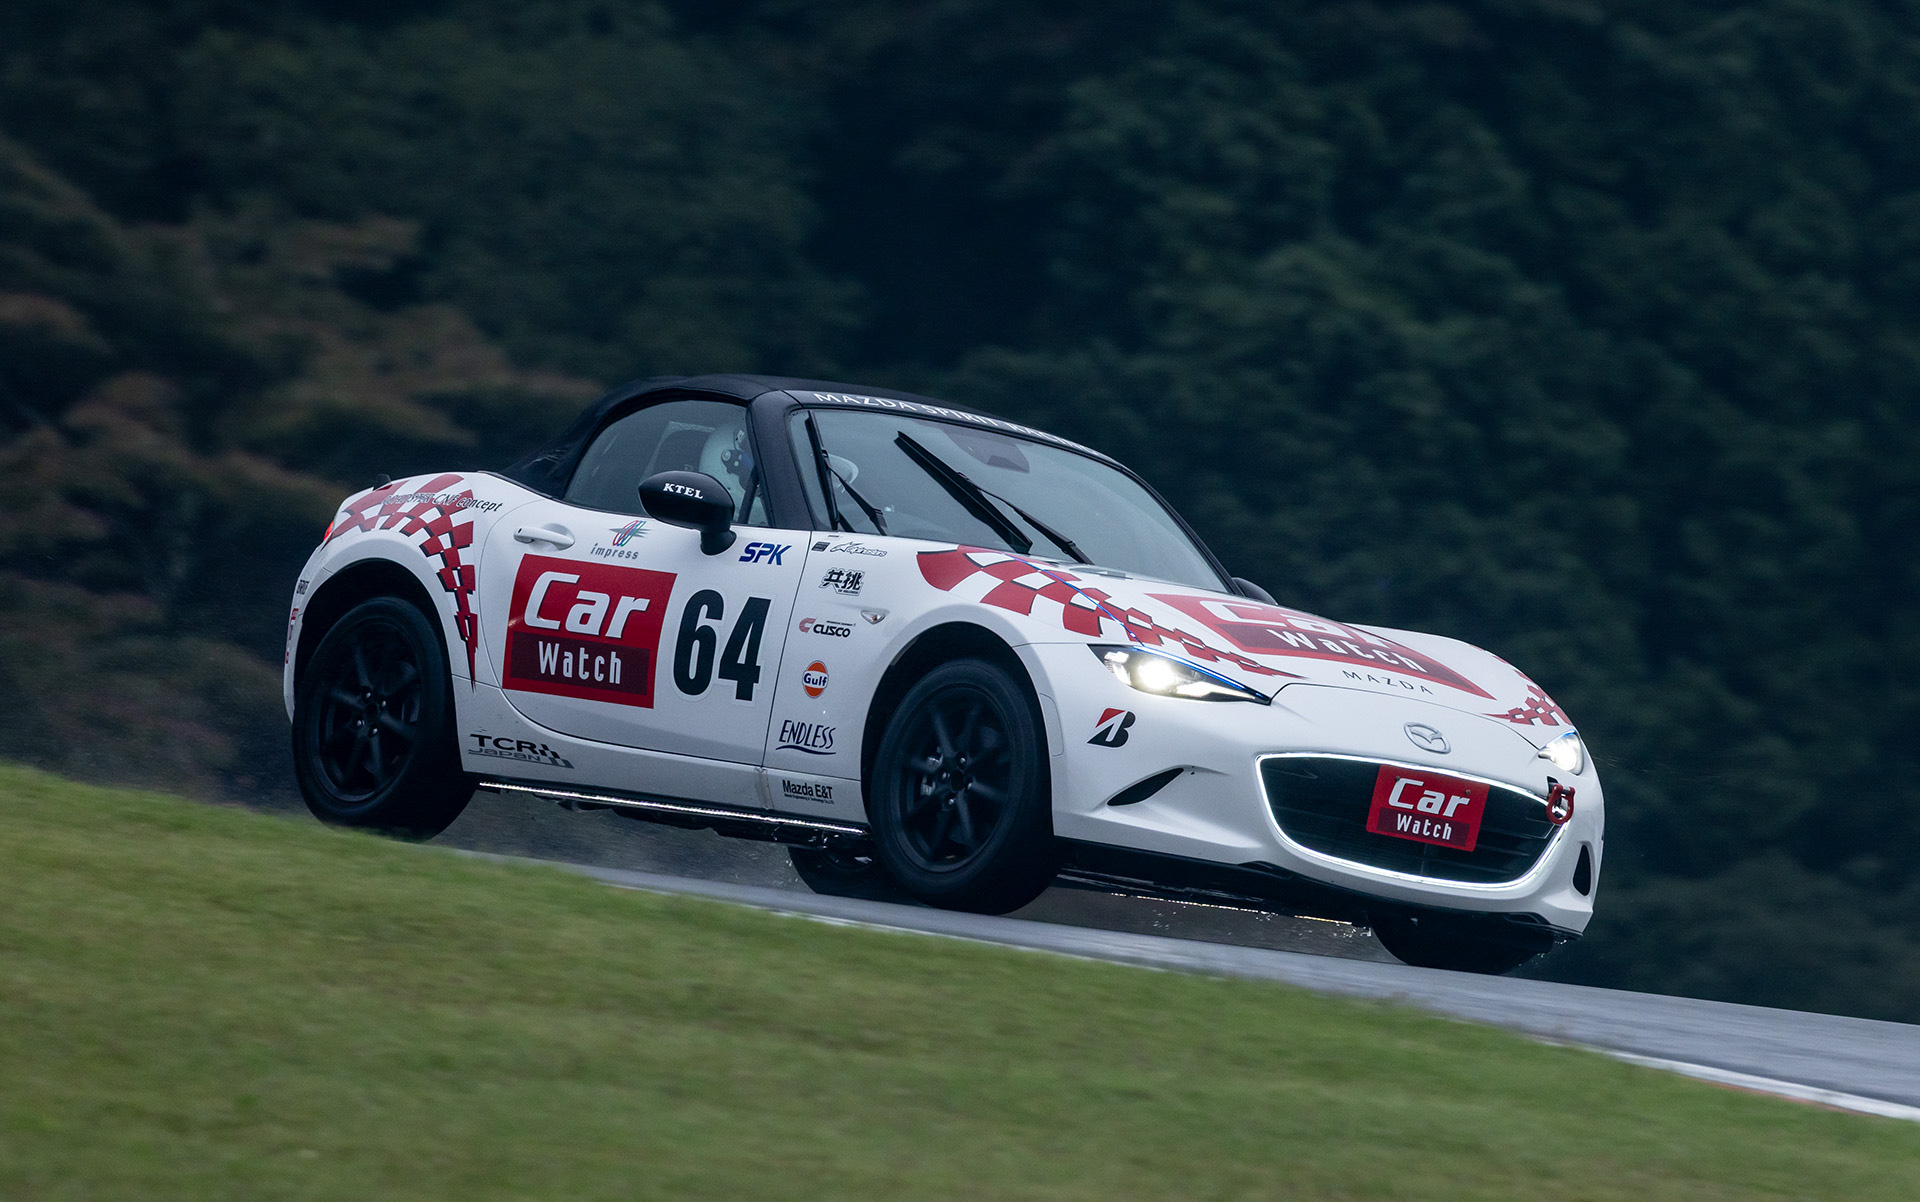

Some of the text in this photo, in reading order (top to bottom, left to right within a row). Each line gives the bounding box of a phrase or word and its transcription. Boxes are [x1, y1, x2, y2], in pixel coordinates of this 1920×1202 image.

[814, 393, 917, 412] MAZDA
[921, 404, 1000, 427] SPIRIT
[663, 482, 704, 500] KTEL
[456, 496, 503, 514] concept
[591, 542, 639, 560] impress
[738, 542, 793, 566] SPK
[524, 571, 650, 639] Car
[812, 622, 851, 638] CUSCO
[1199, 600, 1398, 651] Car
[673, 588, 772, 702] 64
[1266, 628, 1428, 674] Watch
[538, 640, 622, 685] Watch
[803, 672, 828, 687] Gulf
[1342, 669, 1434, 696] MAZDA
[470, 733, 539, 755] TCR
[778, 719, 836, 750] ENDLESS
[782, 779, 814, 797] Mazda
[814, 784, 833, 800] E&T
[1388, 778, 1471, 818] Car
[1396, 813, 1453, 841] Watch
